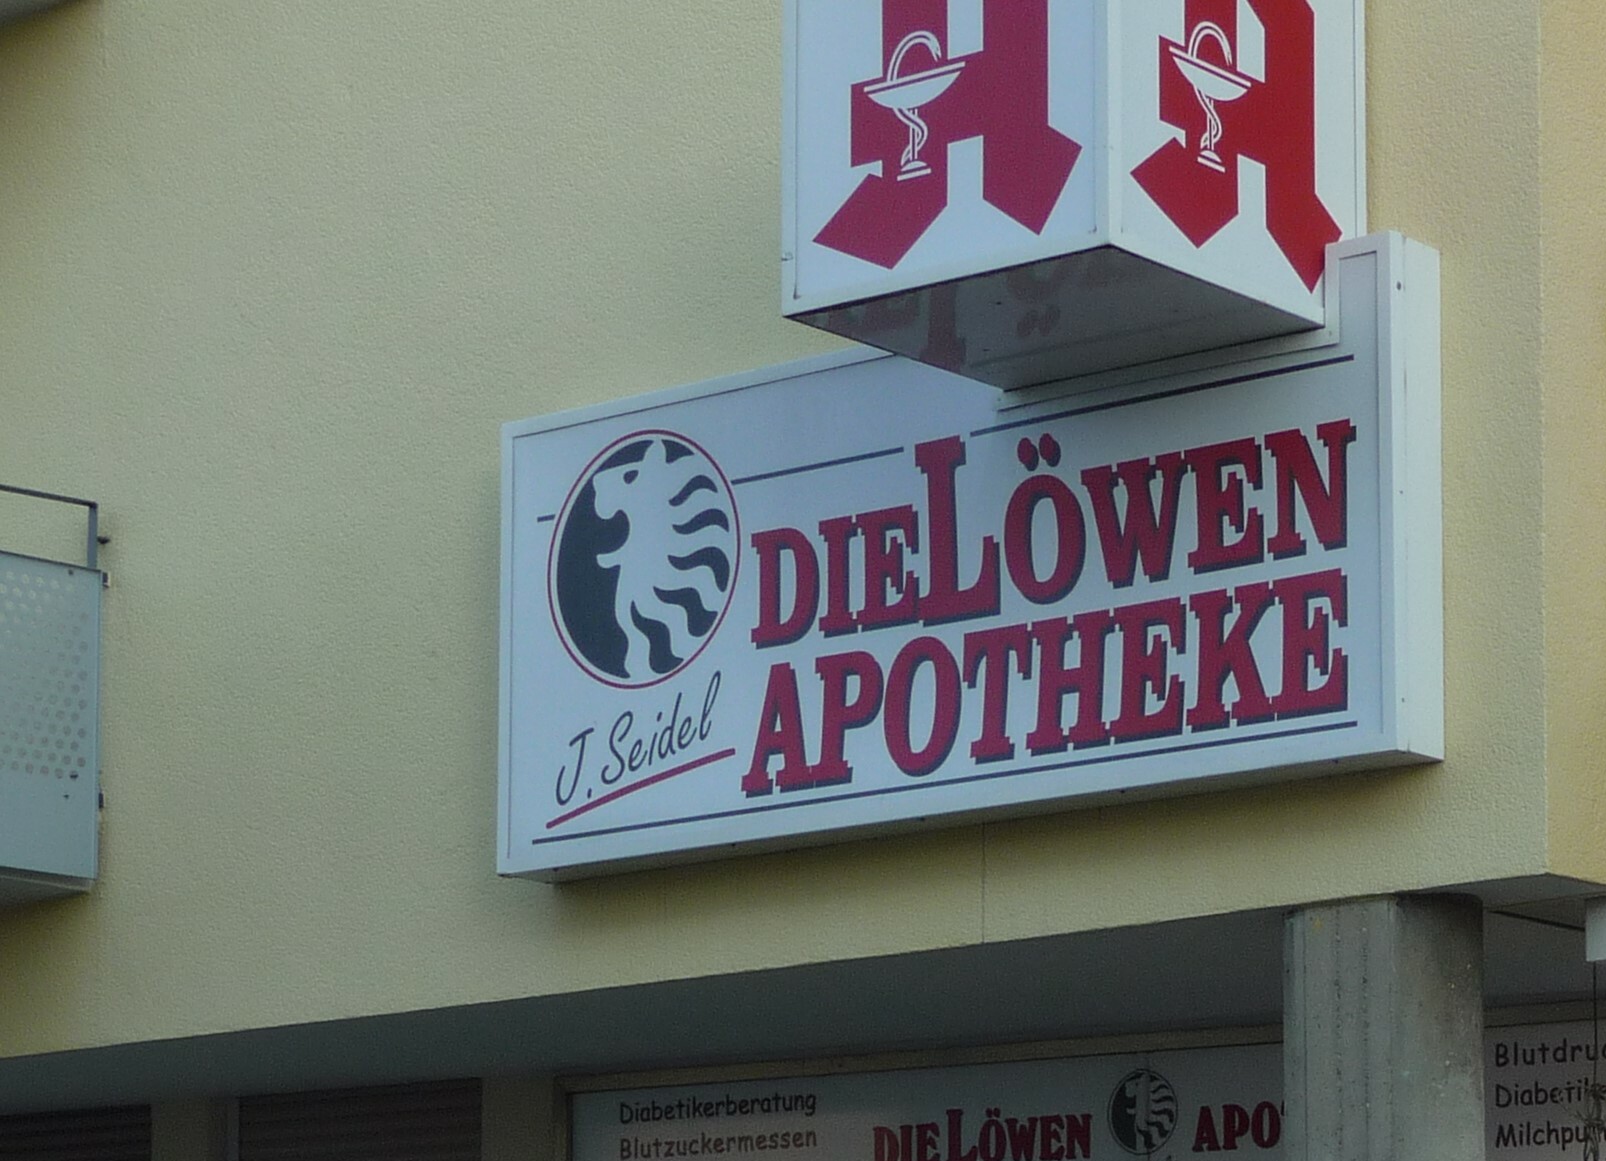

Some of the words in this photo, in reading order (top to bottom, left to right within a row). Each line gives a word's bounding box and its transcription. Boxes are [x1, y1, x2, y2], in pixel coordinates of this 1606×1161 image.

[750, 504, 921, 650] DIE
[914, 418, 1357, 624] LÖWEN
[741, 568, 1349, 797] APOTHEKE
[554, 728, 595, 806] J.
[599, 671, 724, 785] Seidel
[619, 1092, 817, 1126] Diabetikerberatung
[619, 1126, 817, 1161] Blutzuckermessen
[1192, 1100, 1285, 1153] APO
